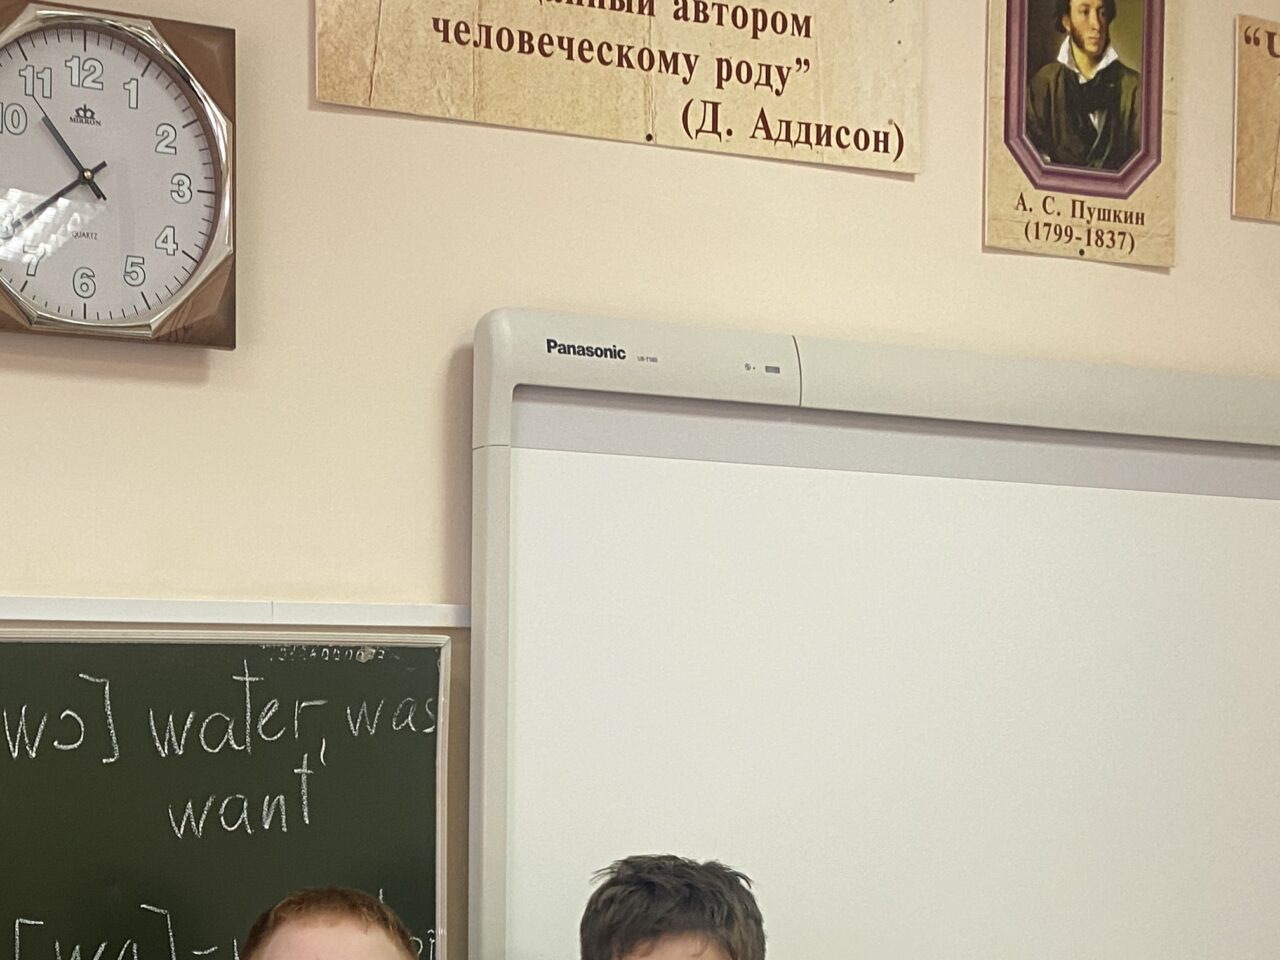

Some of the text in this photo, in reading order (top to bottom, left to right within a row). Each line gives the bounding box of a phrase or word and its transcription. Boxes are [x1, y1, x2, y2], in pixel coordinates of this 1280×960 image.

[673, 0, 813, 38] автором
[432, 15, 700, 84] человеческому
[19, 65, 53, 99] 11
[65, 55, 104, 91] 12
[123, 77, 139, 109] 1
[155, 123, 177, 155] 2
[681, 97, 905, 163] (Д. Аддисон)
[170, 173, 193, 205] 3
[1014, 192, 1146, 226] А. С. Пушкин
[71, 230, 98, 241] QUARTZ
[155, 225, 178, 256] 4
[1024, 221, 1136, 255] (1799-1837)
[22, 244, 47, 277] 7
[123, 255, 146, 287] 5
[72, 266, 96, 299] 6
[546, 338, 627, 361] Panasonic
[168, 753, 314, 840] want
